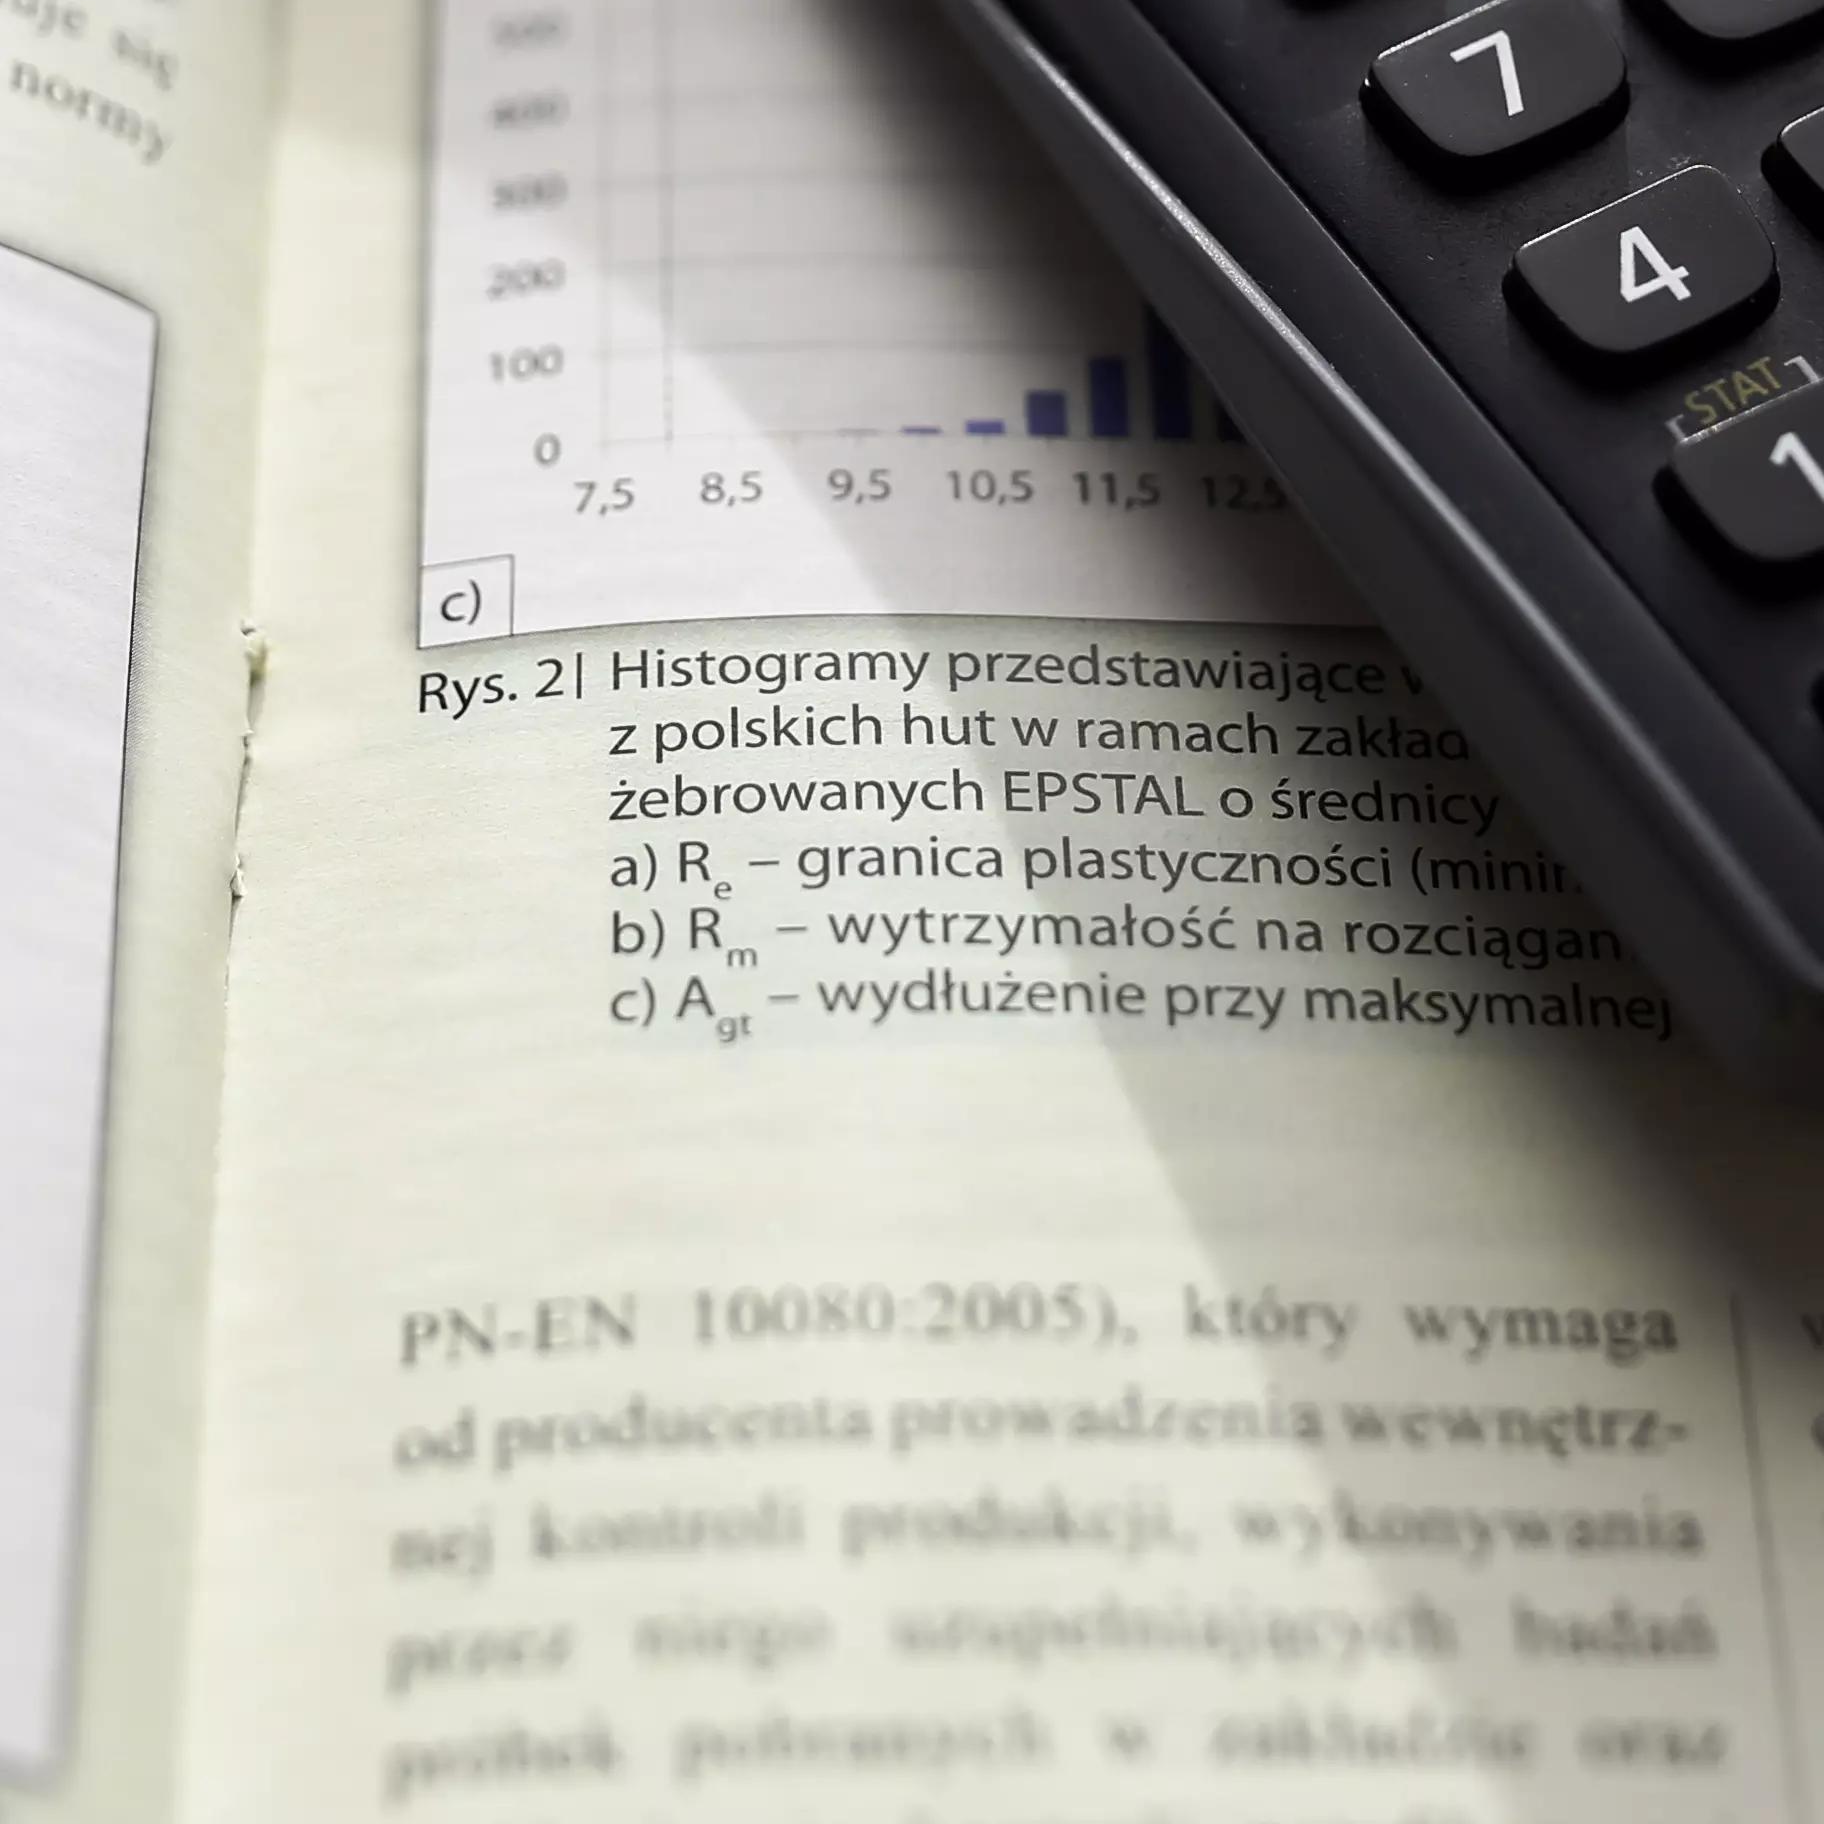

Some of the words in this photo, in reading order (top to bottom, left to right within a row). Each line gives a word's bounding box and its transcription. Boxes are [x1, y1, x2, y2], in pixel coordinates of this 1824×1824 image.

[1449, 29, 1526, 118] 7
[8, 58, 174, 166] normy
[485, 258, 567, 302] 200
[1618, 224, 1692, 305] 4
[488, 344, 564, 385] 100
[534, 433, 561, 466] 0
[574, 478, 635, 517] 7,5
[700, 470, 763, 506] 8,5
[829, 469, 892, 505] 9,5
[948, 469, 1035, 506] 10,5
[1073, 471, 1162, 510] 11,5
[440, 579, 482, 626] c)
[417, 670, 518, 721] Rys.
[611, 648, 930, 695] Histogramy
[947, 644, 1387, 704] przedstawiające
[608, 721, 639, 757] z
[654, 705, 884, 764] polskich
[902, 702, 996, 747] hut
[1011, 714, 1059, 749] w
[1077, 710, 1279, 756] ramach
[608, 768, 985, 822] żebrowanych
[1003, 770, 1204, 818] EPSTAL
[1218, 784, 1255, 820] o
[1270, 776, 1500, 837] średnicy
[609, 842, 658, 893] a)
[797, 835, 1004, 890] granica
[1024, 836, 1393, 893] plastyczności
[611, 909, 666, 959] b)
[828, 904, 1238, 957] wytrzymałość
[1256, 919, 1324, 954] na
[1344, 918, 1636, 972] rozciągan
[610, 978, 657, 1029] c)
[818, 966, 1147, 1026] wydłużenie
[1166, 978, 1286, 1030] przy
[1305, 978, 1673, 1041] maksymalnej
[400, 1290, 637, 1367] PN-EN
[694, 1279, 1138, 1347] 10080:2005),
[1183, 1283, 1358, 1362] który
[1403, 1300, 1678, 1368] wymaga
[393, 1405, 477, 1470] od
[493, 1390, 873, 1478] producenta
[890, 1385, 1323, 1457] prowadzenia
[1340, 1399, 1688, 1467] wewnętrz-
